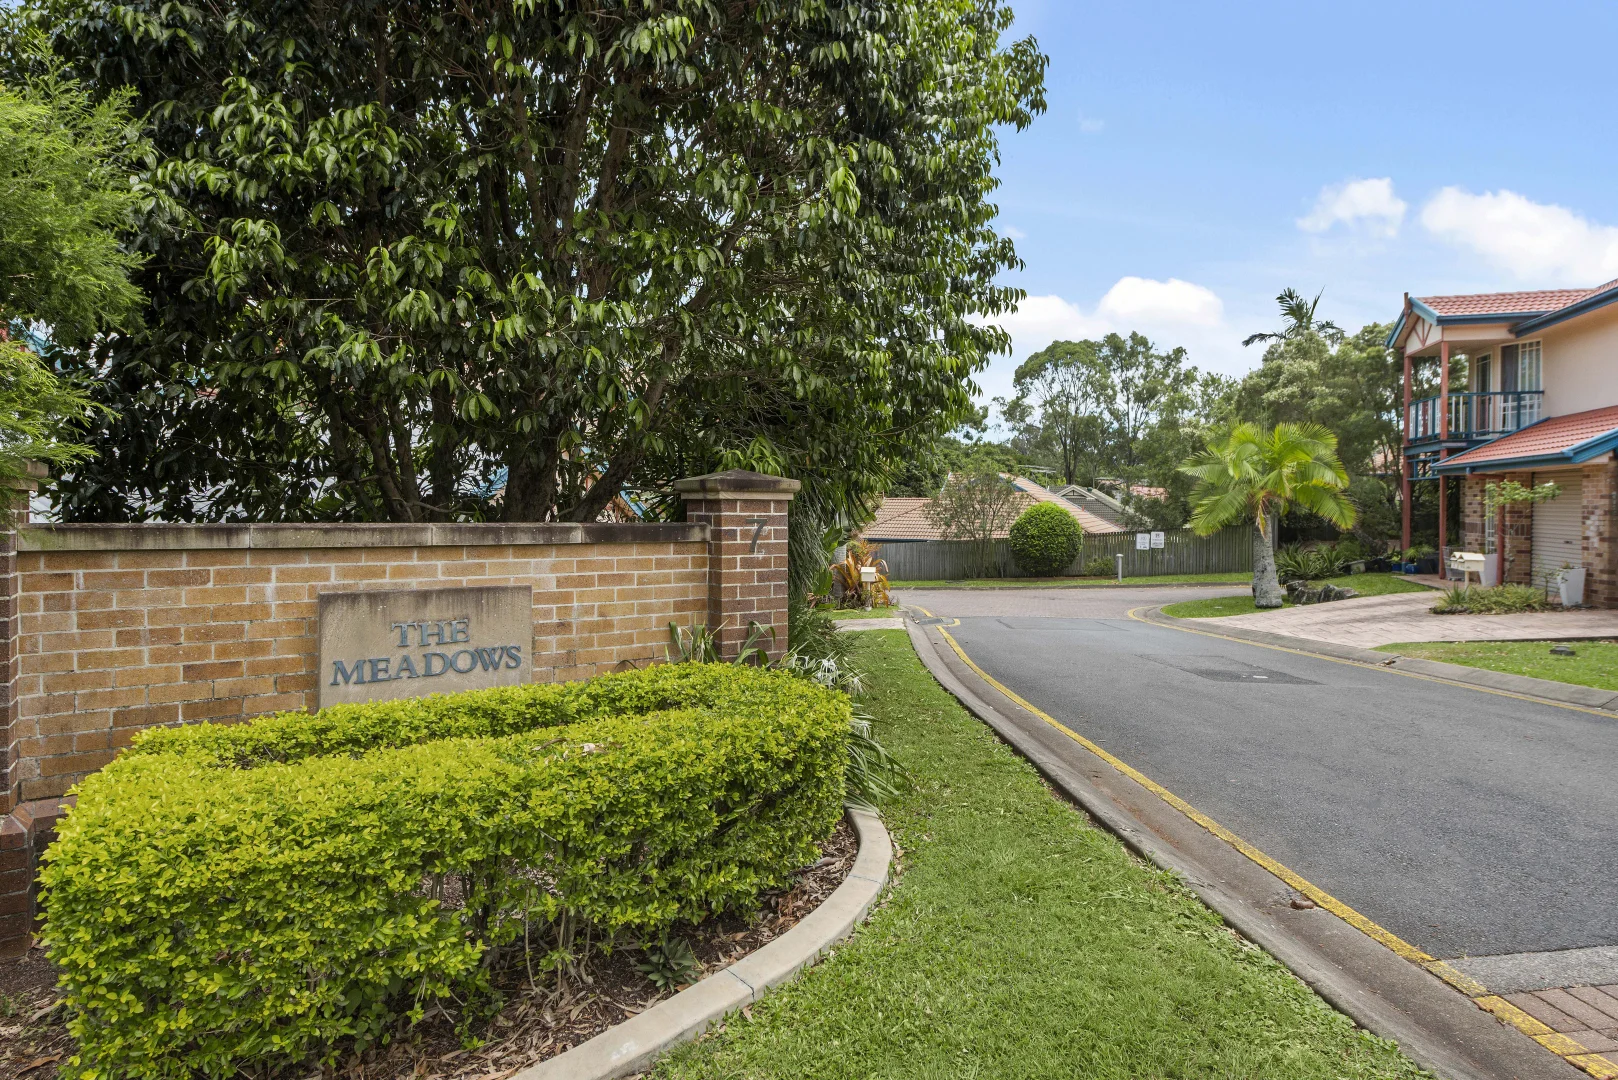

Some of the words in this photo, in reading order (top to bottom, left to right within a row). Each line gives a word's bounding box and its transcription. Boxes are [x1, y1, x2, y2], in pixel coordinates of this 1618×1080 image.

[745, 518, 768, 552] 7
[391, 618, 470, 647] THE
[330, 646, 522, 686] MEADOWS
